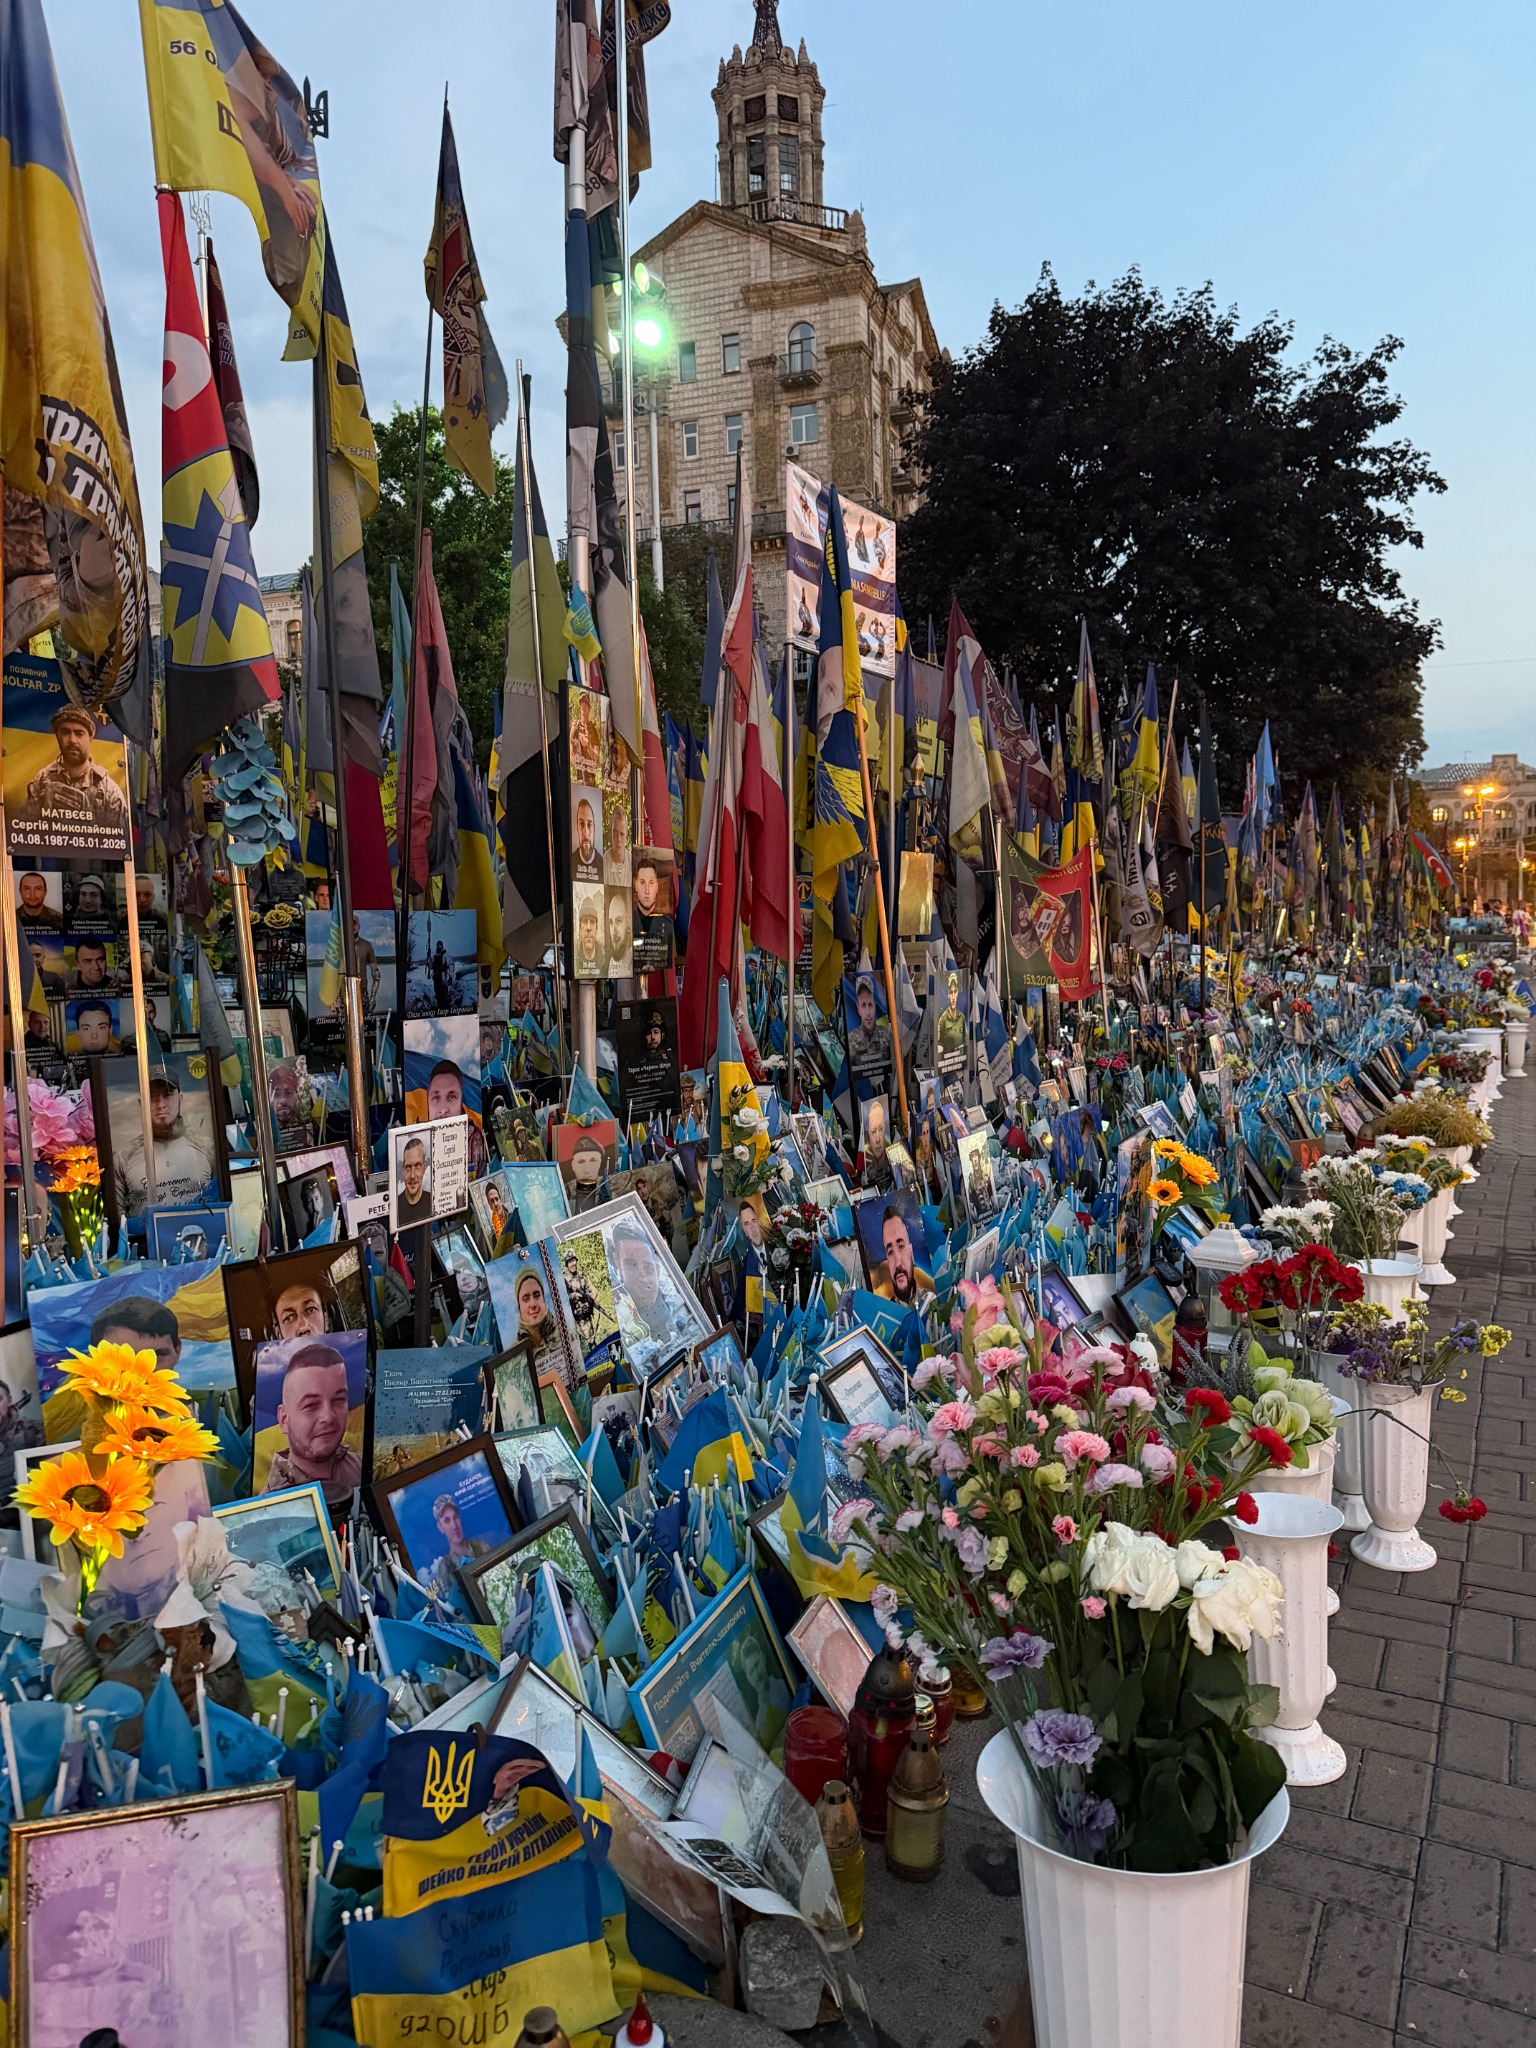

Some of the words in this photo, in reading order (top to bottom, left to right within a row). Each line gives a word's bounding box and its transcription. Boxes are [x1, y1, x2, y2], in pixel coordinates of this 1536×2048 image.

[170, 40, 197, 55] 56
[9, 665, 48, 678] ПОЗИВНИЙ
[41, 807, 93, 820] МАТВЄЄВ
[11, 819, 49, 831] Сергій
[51, 821, 124, 836] Миколайович
[10, 832, 127, 849] 04.08.1987-05.01.2026
[368, 1204, 386, 1215] PETE
[467, 1839, 508, 1864] ГЕРОЙ
[418, 1865, 465, 1898] ШЕЙКО
[467, 1849, 521, 1879] АНДРІЙ
